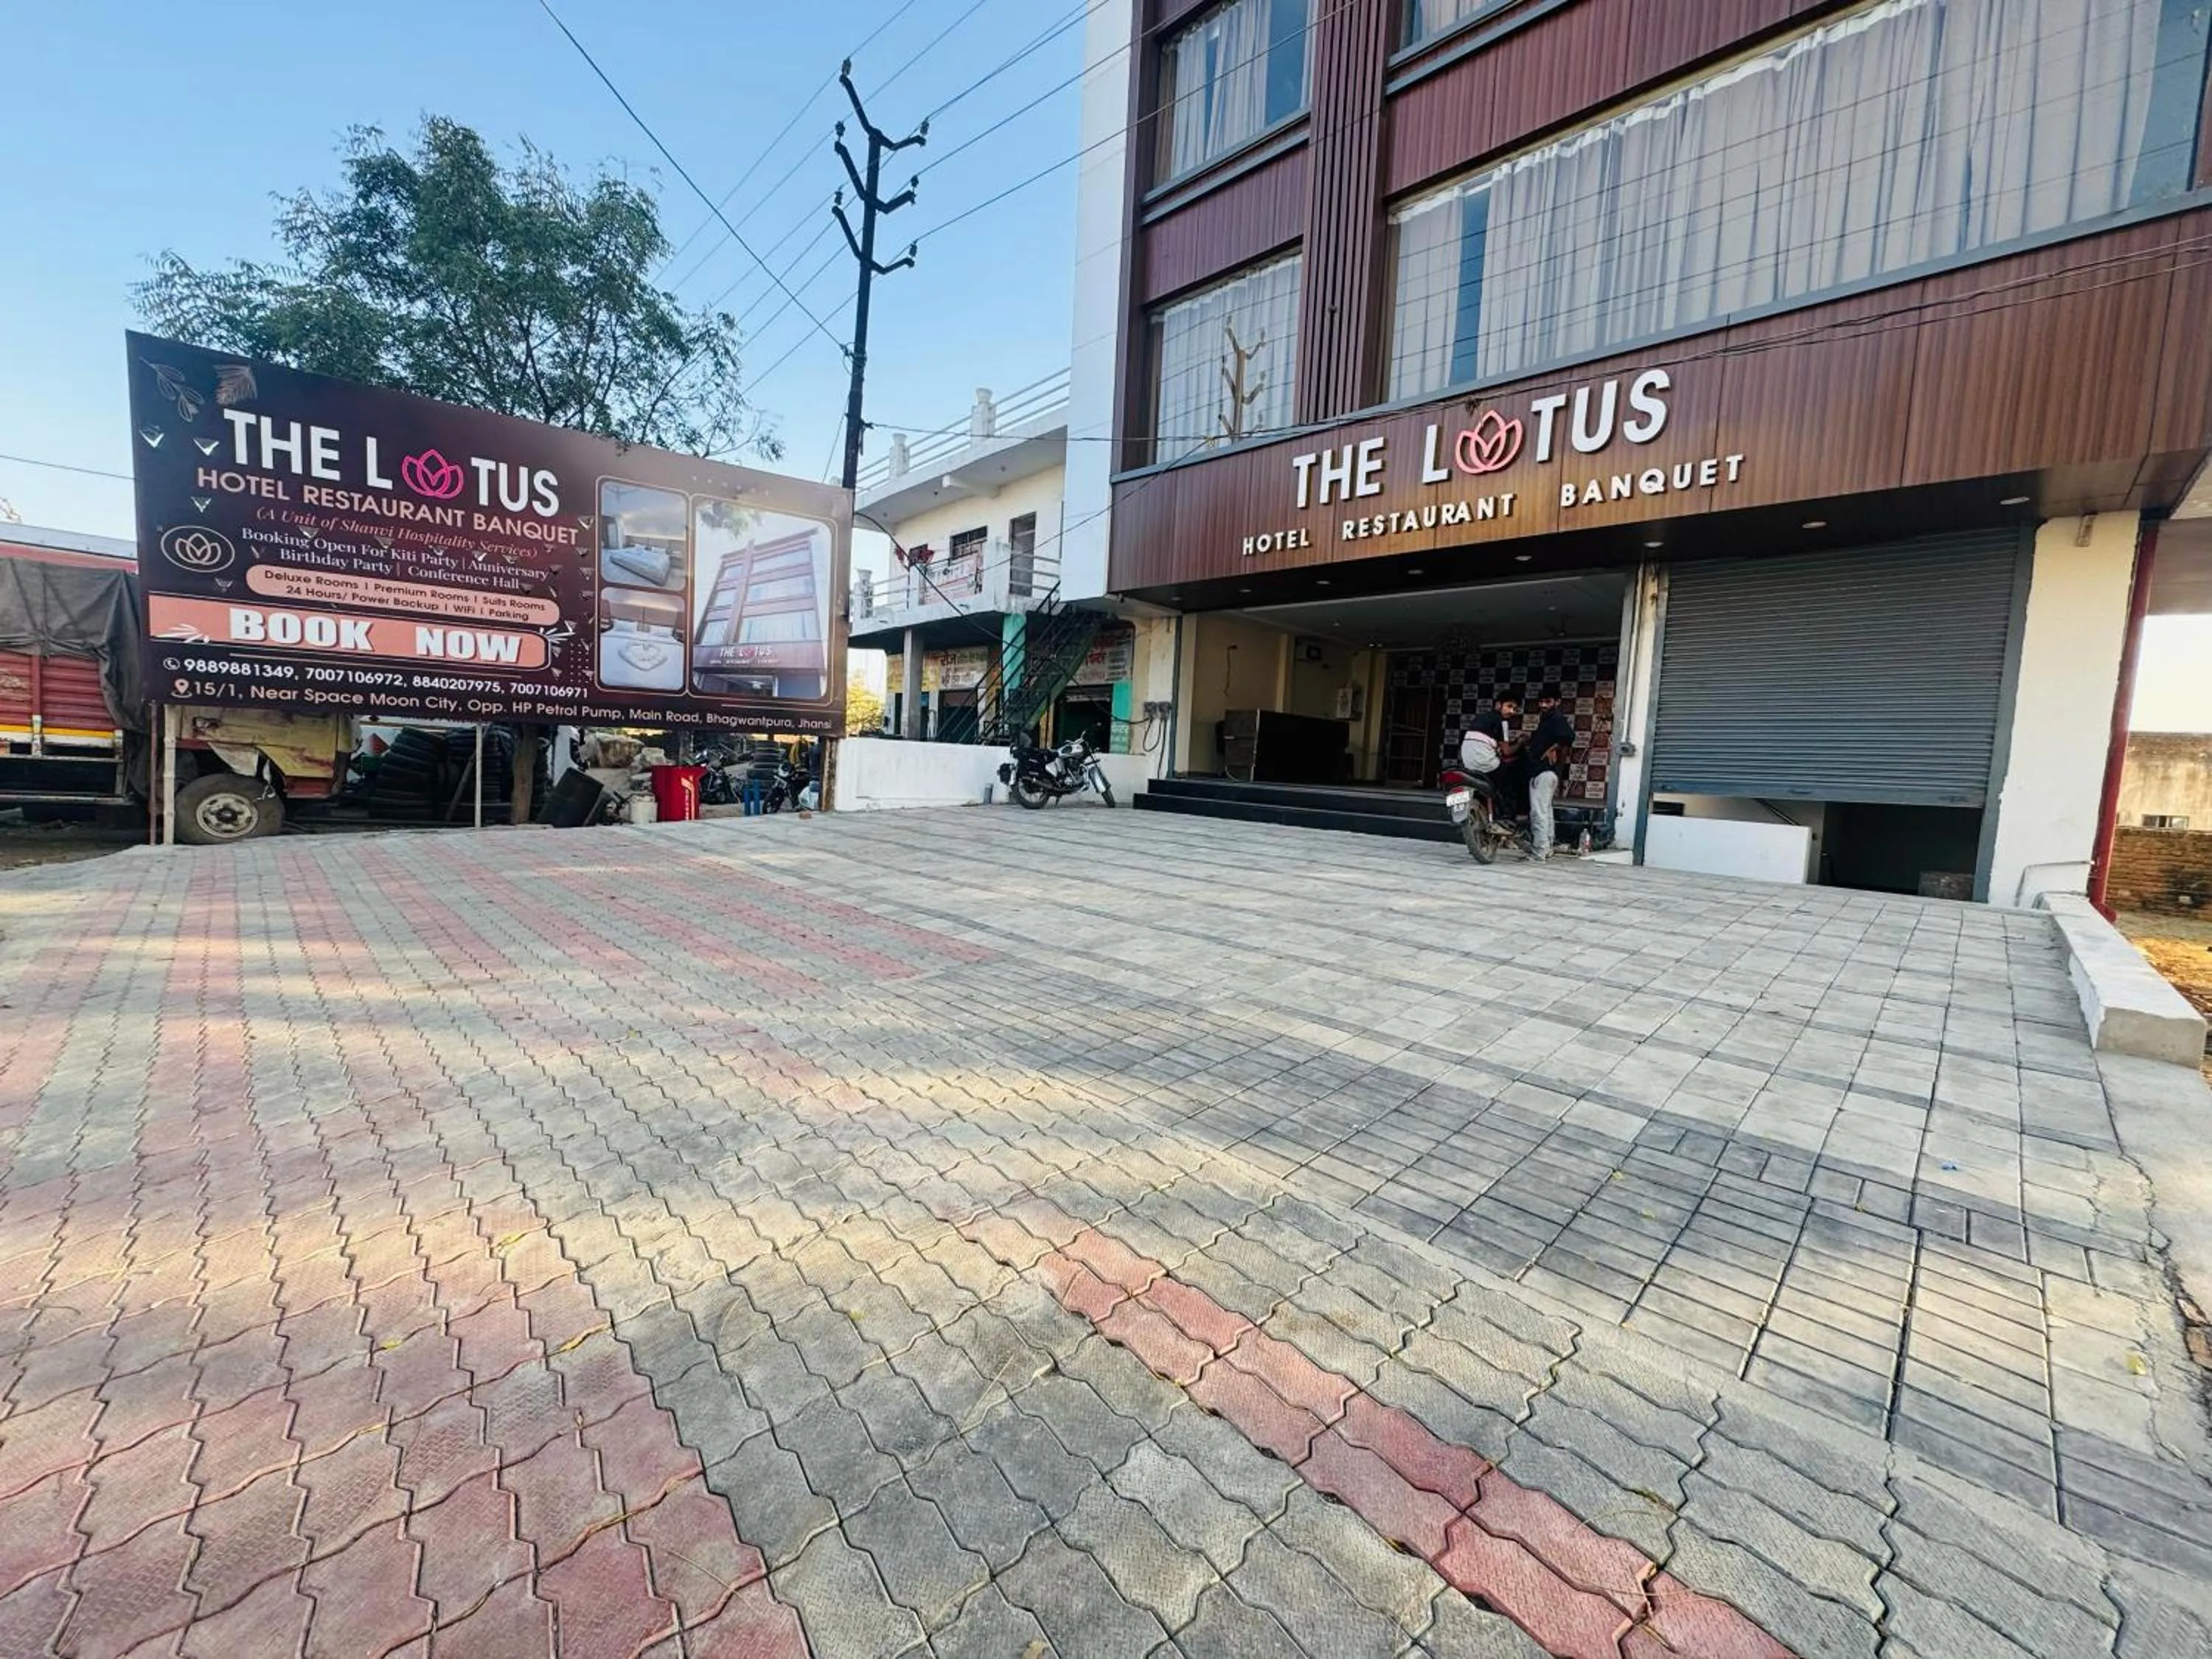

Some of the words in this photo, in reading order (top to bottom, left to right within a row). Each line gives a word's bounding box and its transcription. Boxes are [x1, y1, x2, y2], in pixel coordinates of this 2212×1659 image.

[223, 408, 341, 481] THE
[1292, 437, 1385, 509] THE
[197, 467, 290, 501] HOTEL
[303, 487, 465, 528] RESTAURANT
[473, 512, 578, 546] BANQUET
[1242, 526, 1310, 556] HOTEL
[1341, 493, 1517, 542] RESTAURANT
[1560, 453, 1746, 509] BANQUET
[242, 527, 310, 549] Booking
[313, 538, 356, 553] Open
[421, 552, 459, 569] Party
[282, 509, 316, 526] Unit
[320, 517, 338, 532] of
[398, 527, 476, 551] Hospitality
[280, 548, 349, 570] Birthday
[353, 557, 392, 576] Party
[408, 566, 490, 585] Conference
[493, 575, 519, 589] Hall
[265, 570, 312, 583] Deluxe
[316, 576, 359, 589] Rooms
[374, 583, 427, 597] Premium
[431, 590, 470, 602] Rooms
[509, 599, 546, 611] Rooms
[285, 585, 302, 595] 24
[352, 592, 389, 604] Power
[392, 598, 439, 611] Backup
[489, 608, 529, 622] Parking
[229, 607, 375, 652] BOOK
[415, 625, 523, 664] NOW
[250, 685, 299, 700] Near
[303, 688, 364, 705] Space
[370, 693, 420, 709] Moon
[425, 696, 462, 712] City,
[512, 703, 532, 714] HP
[536, 703, 577, 717] Petrol
[629, 708, 662, 721] Main
[509, 682, 588, 698] 7007106971
